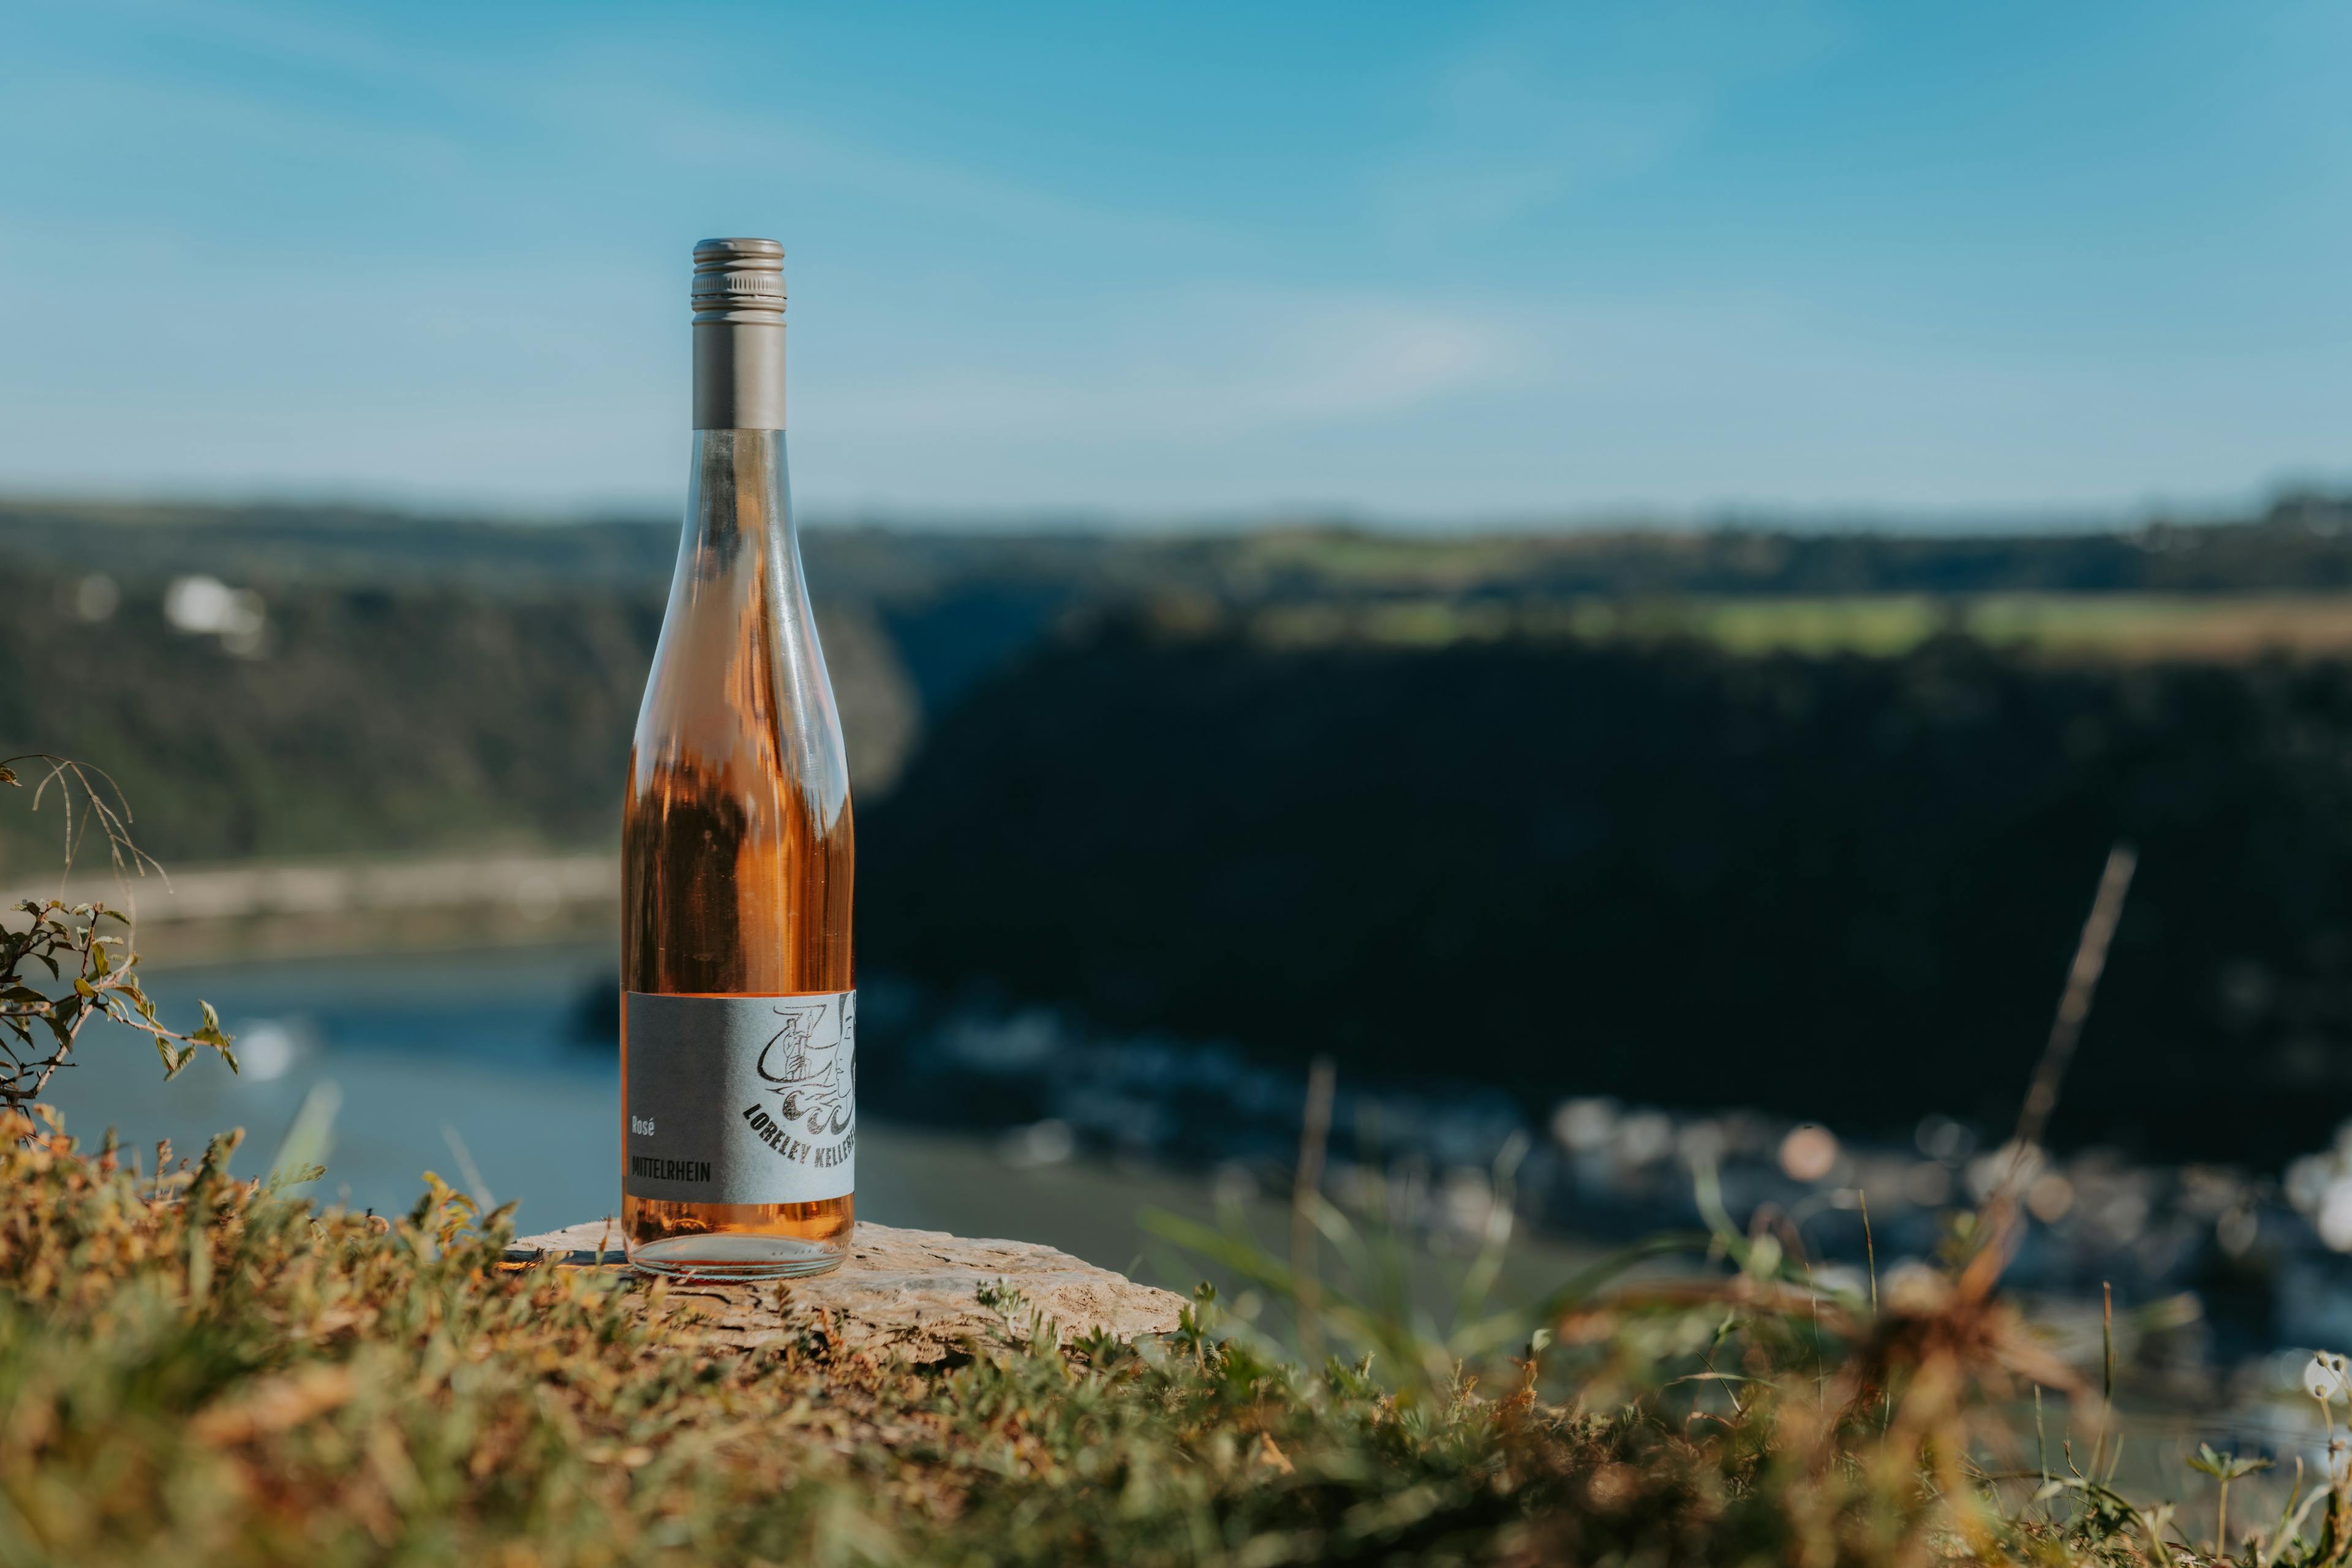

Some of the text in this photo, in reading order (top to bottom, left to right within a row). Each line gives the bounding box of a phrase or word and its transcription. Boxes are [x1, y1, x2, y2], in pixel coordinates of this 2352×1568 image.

[632, 1115, 655, 1136] Rosé
[742, 1103, 812, 1164] LORELEY
[632, 1155, 710, 1182] MITTELRHEIN
